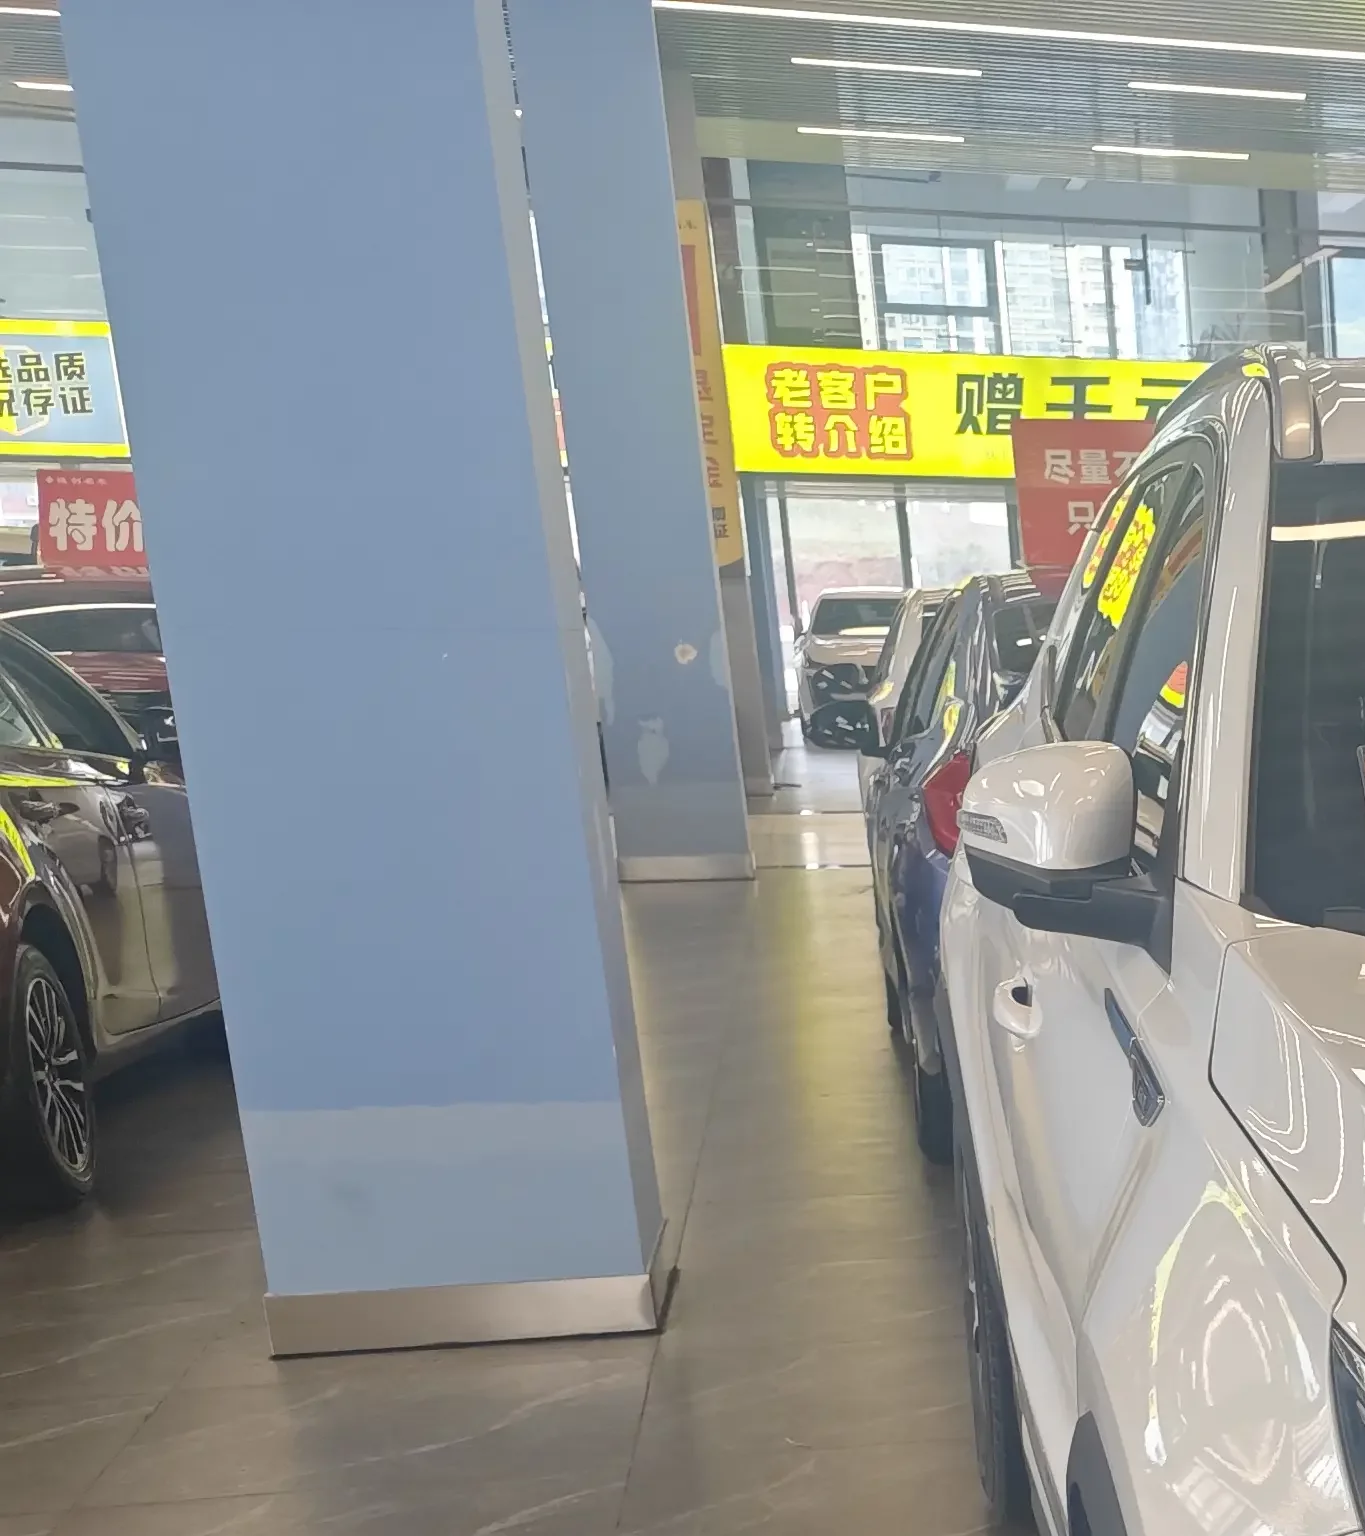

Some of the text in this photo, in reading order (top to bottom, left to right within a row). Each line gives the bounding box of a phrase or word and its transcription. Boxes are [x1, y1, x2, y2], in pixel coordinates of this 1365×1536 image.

[768, 366, 904, 412] 老客户
[773, 412, 908, 456] 转介绍
[49, 498, 144, 552] 特价
